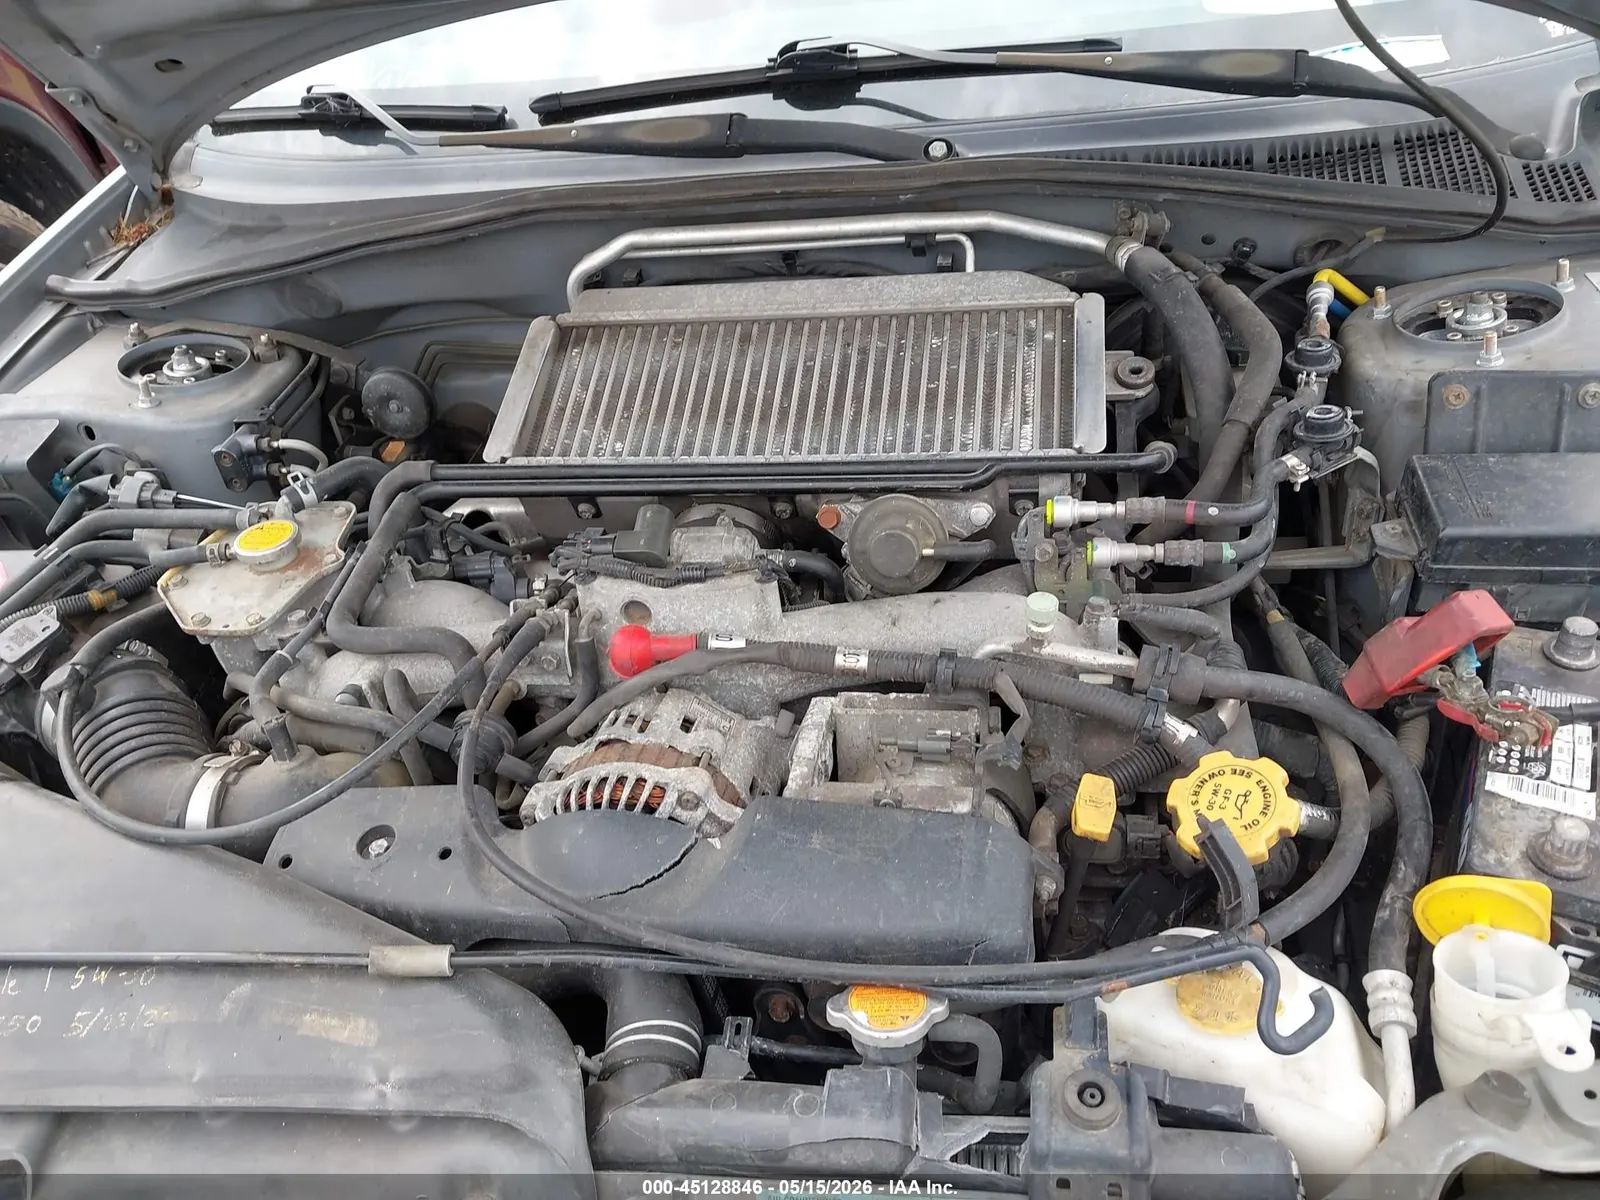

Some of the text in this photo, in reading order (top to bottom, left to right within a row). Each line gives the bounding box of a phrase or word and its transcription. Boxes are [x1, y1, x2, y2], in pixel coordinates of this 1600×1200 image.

[1191, 768, 1253, 806] SEE OWNER'S
[1206, 782, 1222, 811] 5W-30
[1218, 788, 1232, 810] GF-3
[1240, 779, 1272, 831] ENGINE OIL
